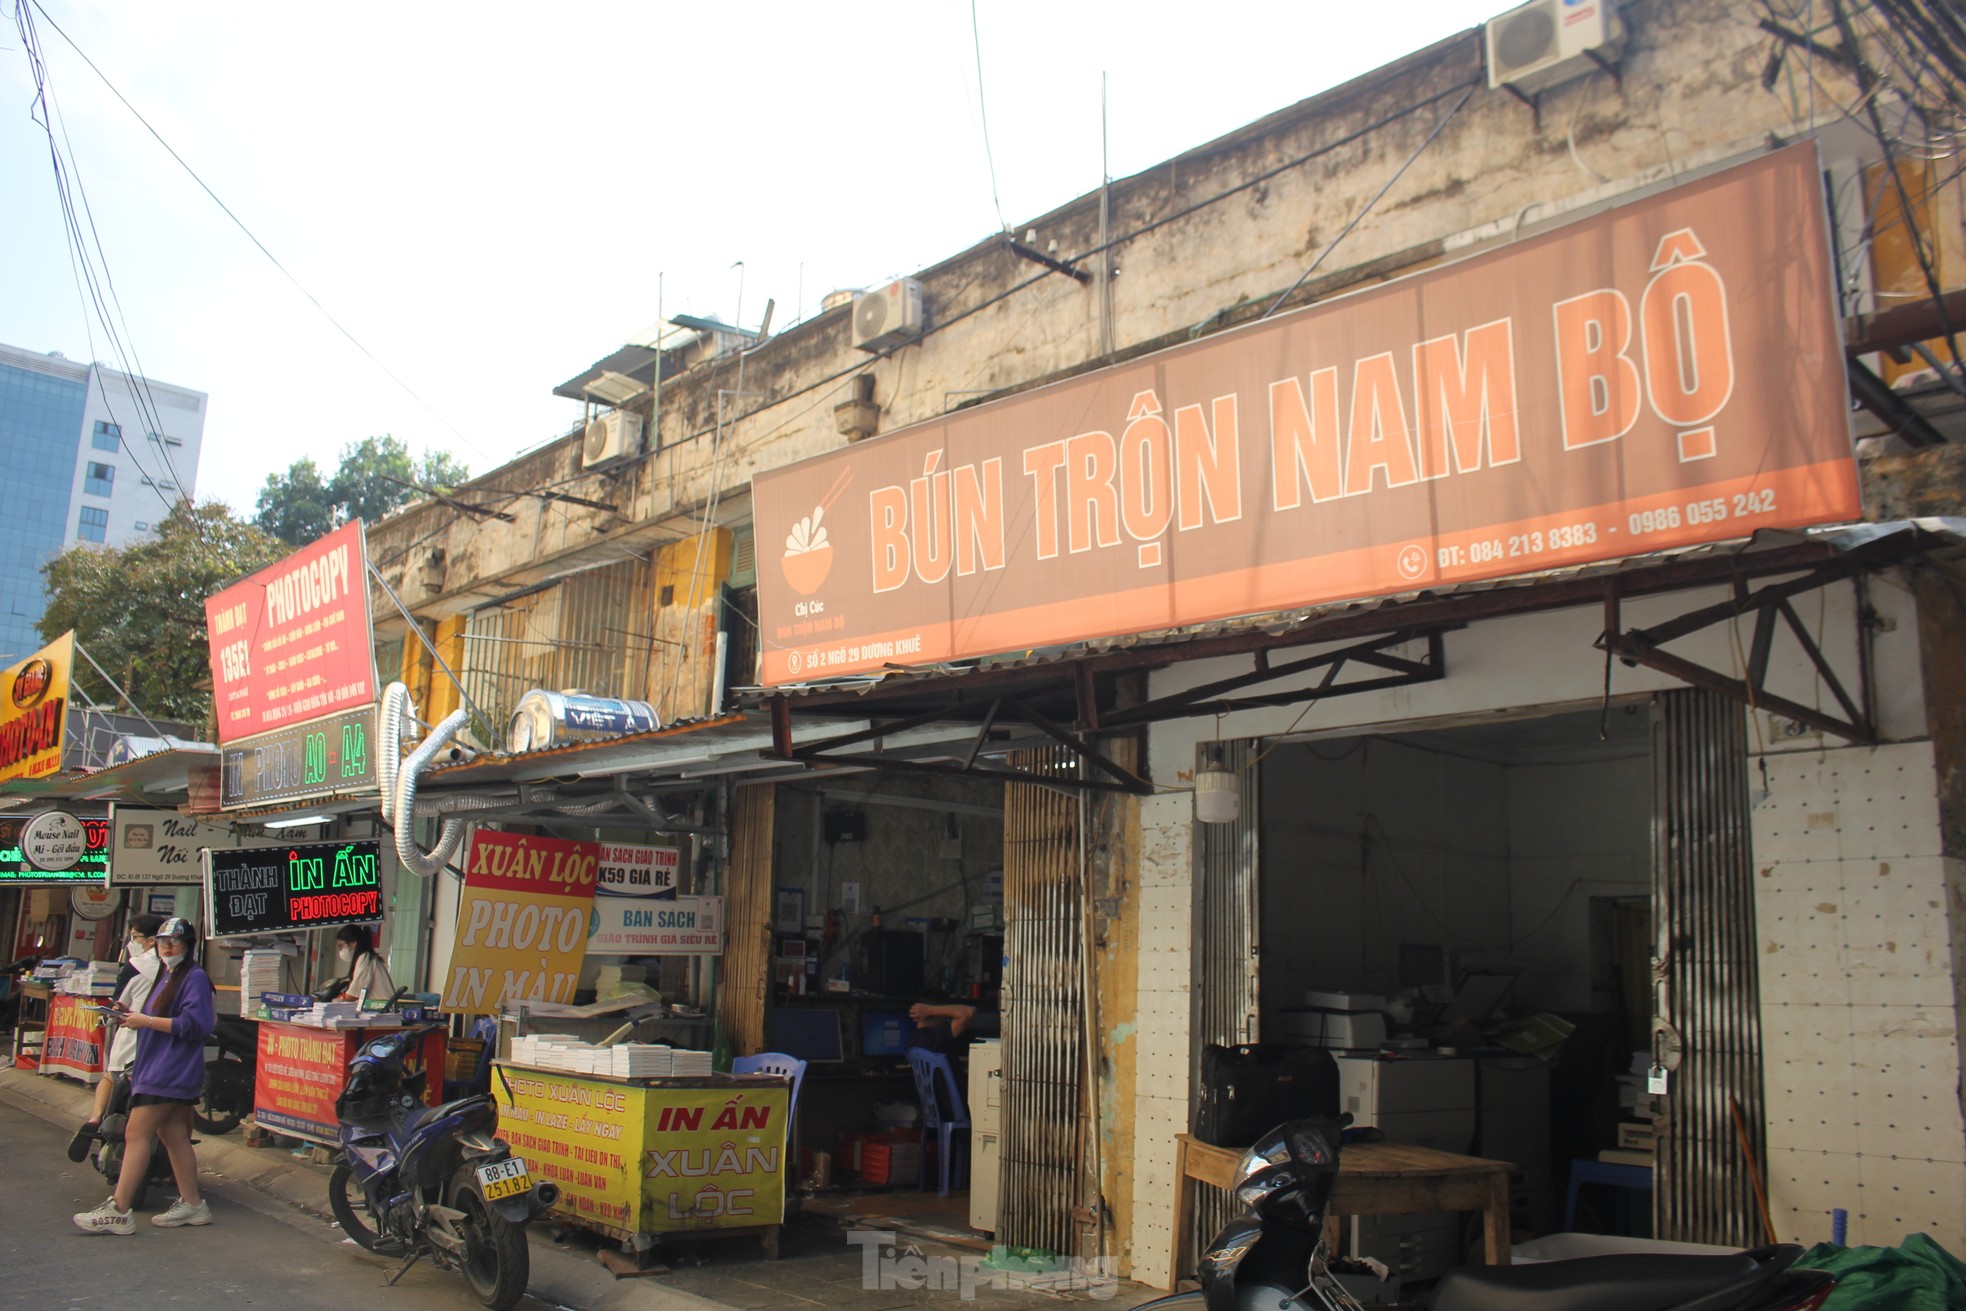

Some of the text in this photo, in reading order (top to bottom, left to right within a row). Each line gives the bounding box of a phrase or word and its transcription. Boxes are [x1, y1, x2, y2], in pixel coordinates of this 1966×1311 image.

[869, 227, 1735, 594] BÚN TRỘN NAM BỘ
[1437, 545, 1466, 568] ĐT:
[1470, 539, 1504, 563] 084
[1508, 531, 1544, 557] 213
[1548, 522, 1598, 550] 8383
[1628, 503, 1680, 537] 0986
[1686, 495, 1728, 527] 055
[1734, 487, 1776, 518] 242
[266, 543, 349, 628] PHOTOCOPY
[794, 603, 808, 618] Chị
[806, 634, 921, 669] SỐ 2 NGÕ 29 DƯƠNG KHUÊ
[255, 738, 301, 793] PHOTO
[341, 723, 367, 778] A4
[163, 818, 199, 838] Nail
[157, 845, 189, 864] Nối
[332, 846, 377, 888] ẤN
[471, 838, 596, 893] XUÂN LỘC
[216, 863, 279, 892] THÀNH
[598, 867, 671, 887] K59 GIÁ RẺ
[229, 892, 268, 920] ĐẠT
[289, 891, 378, 921] PHOTOCOPY
[462, 899, 584, 954] PHOTO
[445, 958, 577, 1010] IN MÀU
[278, 1035, 299, 1060] PHOTO
[500, 1076, 626, 1115] PHOTO XUÂN LỘC
[656, 1093, 771, 1132] IN ẤN
[501, 1102, 510, 1119] IN
[534, 1109, 545, 1125] IN
[545, 1111, 569, 1131] LAZE
[574, 1111, 594, 1135] LẤY
[593, 1121, 624, 1141] NGAY
[484, 1160, 520, 1182] 88-E1
[644, 1140, 779, 1179] XUÂN
[485, 1174, 530, 1200] 251.82
[668, 1183, 755, 1225] LỘC
[91, 1215, 129, 1228] BOSTON
